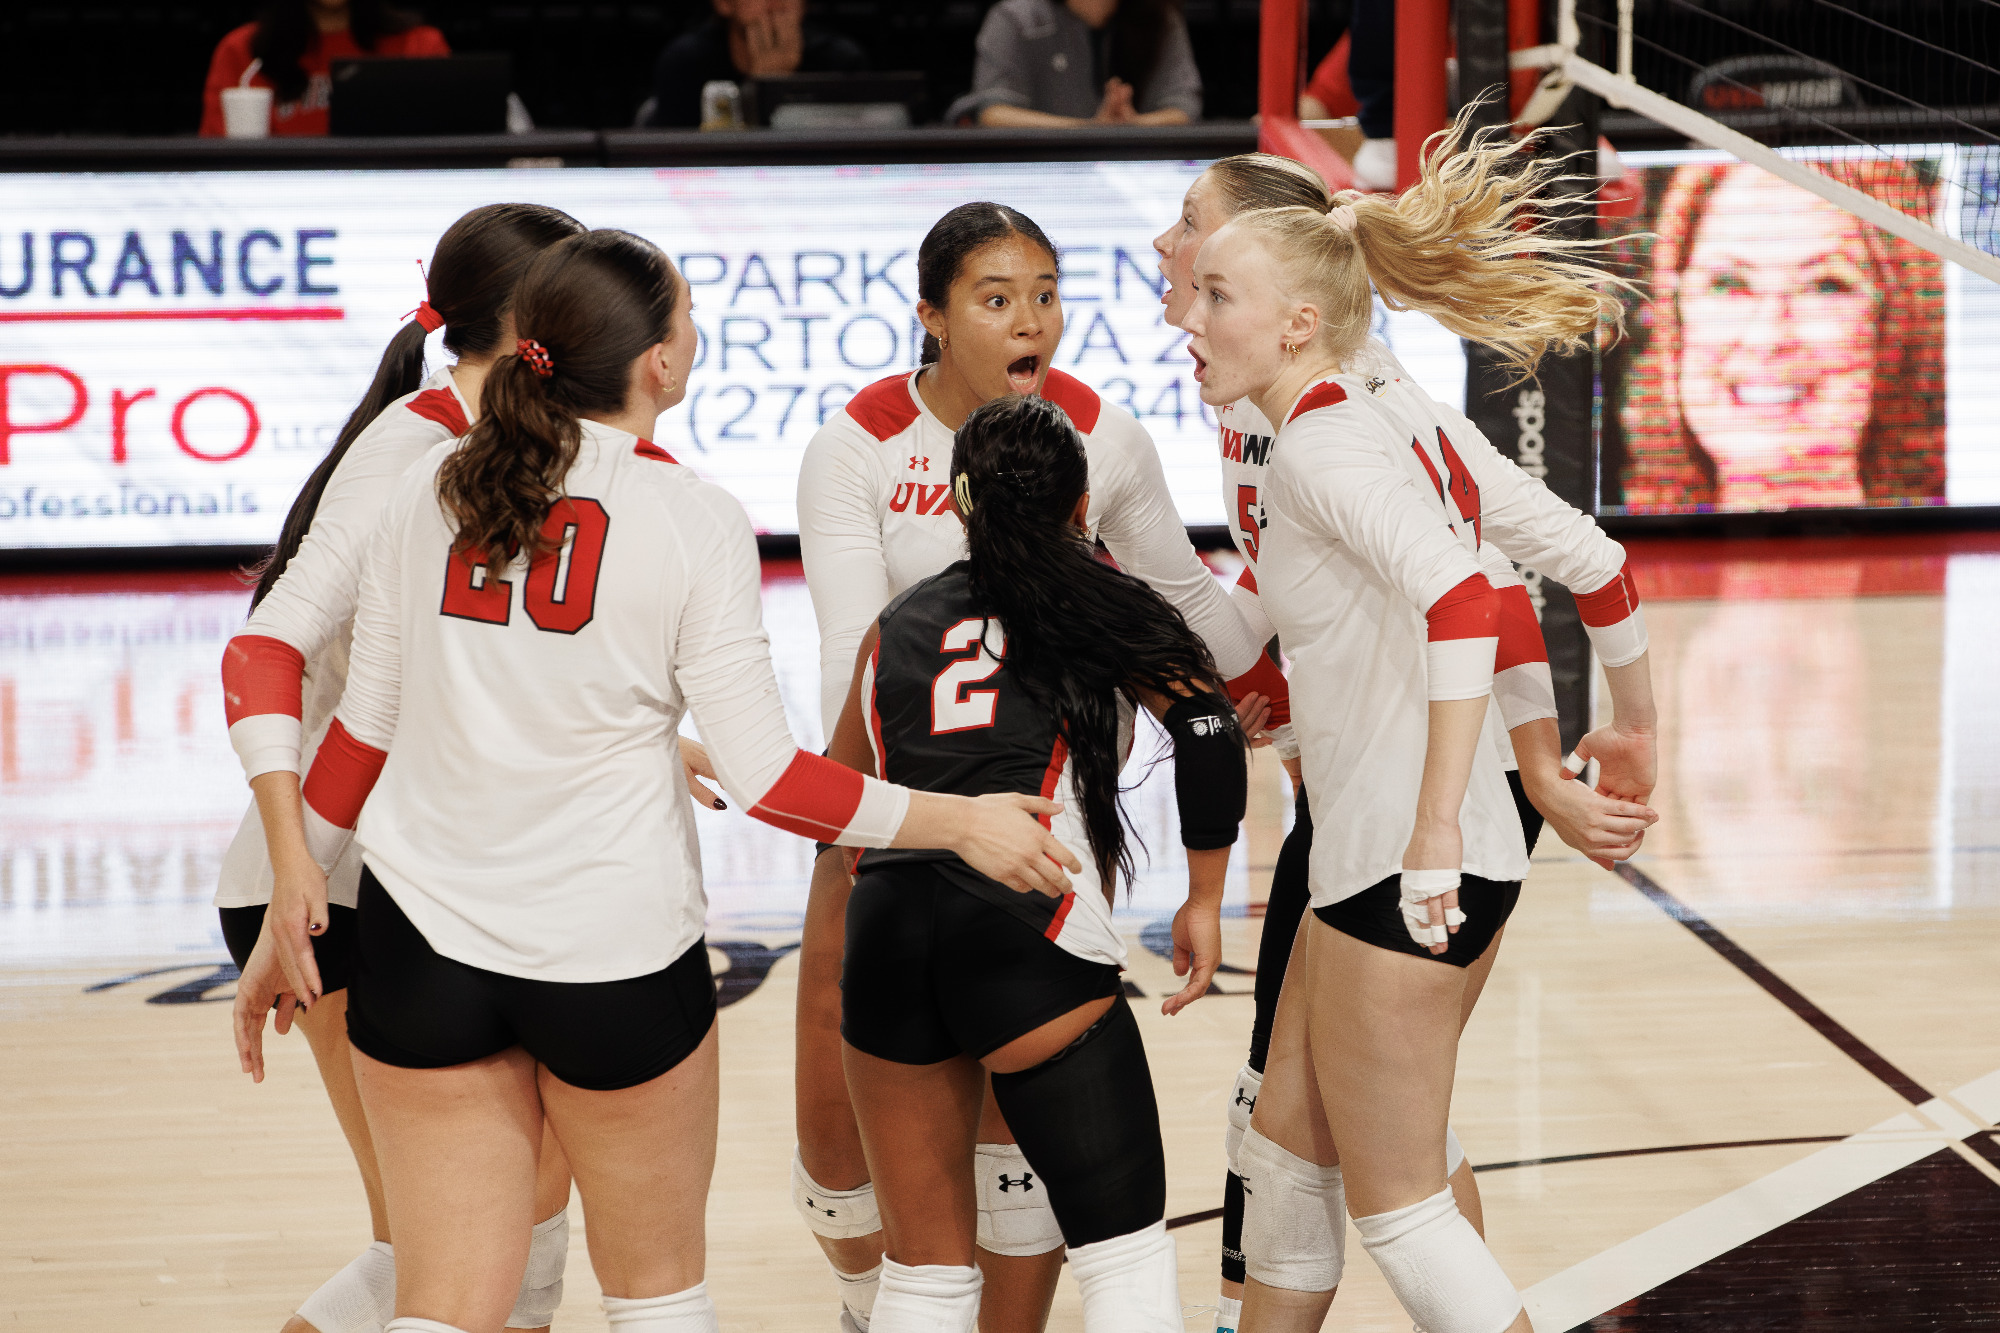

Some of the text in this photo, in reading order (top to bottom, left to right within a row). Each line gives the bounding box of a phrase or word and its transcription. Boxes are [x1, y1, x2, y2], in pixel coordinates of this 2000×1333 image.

[1512, 389, 1549, 479] sport
[439, 496, 611, 636] 20
[930, 615, 1010, 737] 2
